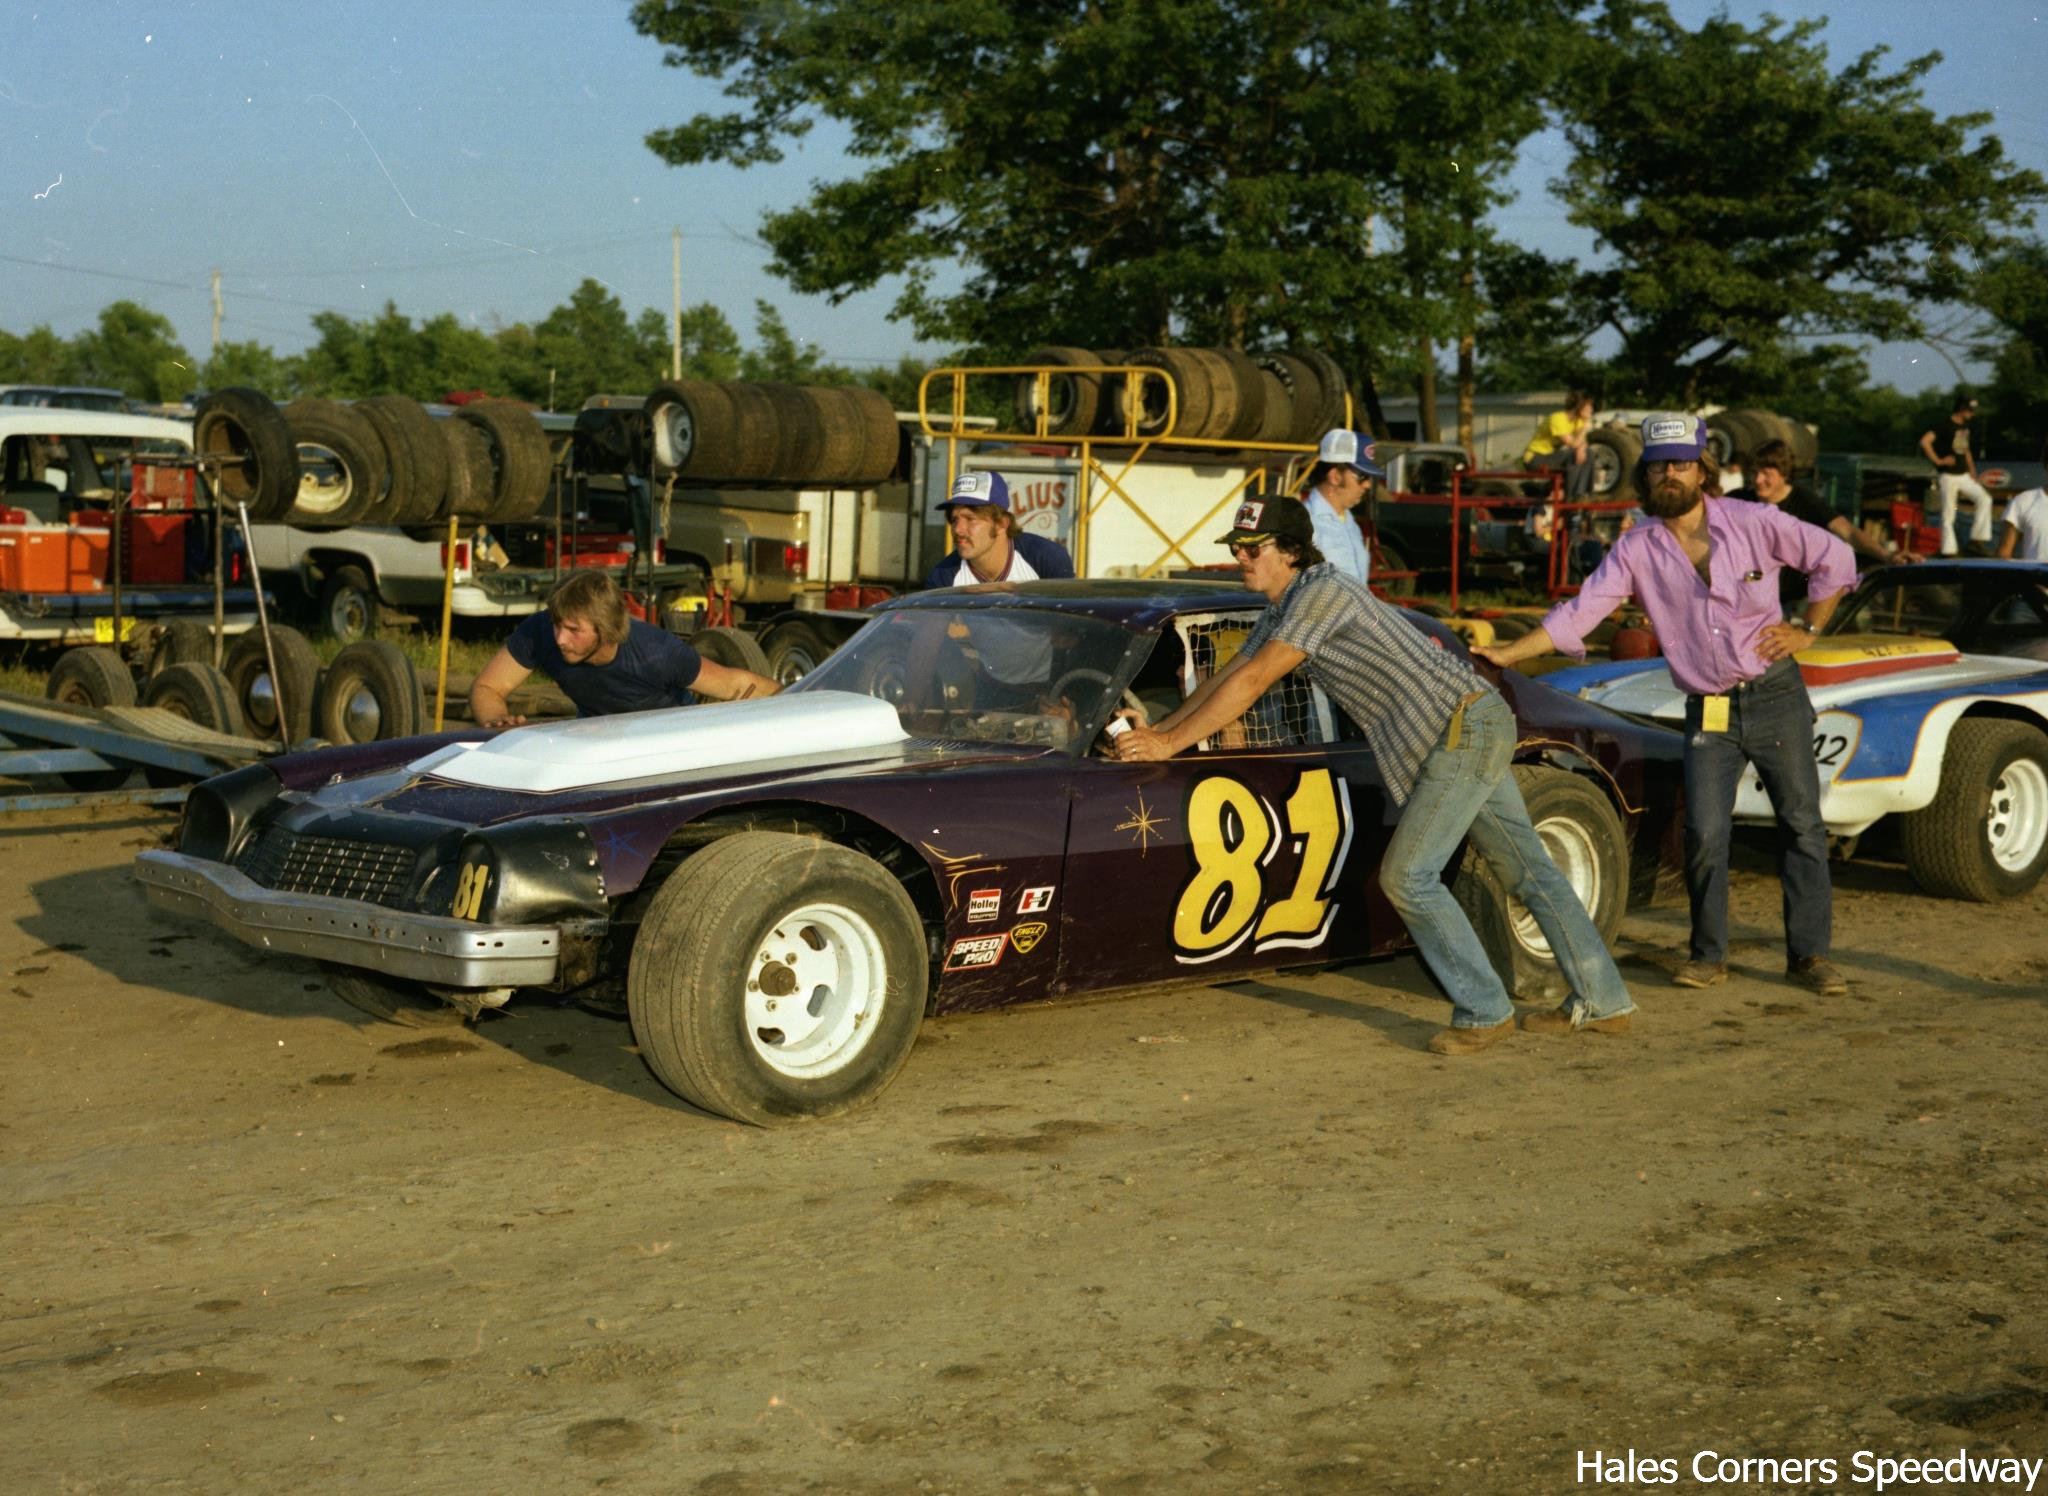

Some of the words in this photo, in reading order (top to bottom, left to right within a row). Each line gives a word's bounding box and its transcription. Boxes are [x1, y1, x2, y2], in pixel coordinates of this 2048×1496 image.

[1012, 481, 1066, 515] LIUS
[1170, 766, 1351, 963] 81
[452, 862, 489, 920] 81
[970, 899, 998, 910] Holley
[953, 938, 1001, 955] SPEED
[963, 950, 995, 965] PRO
